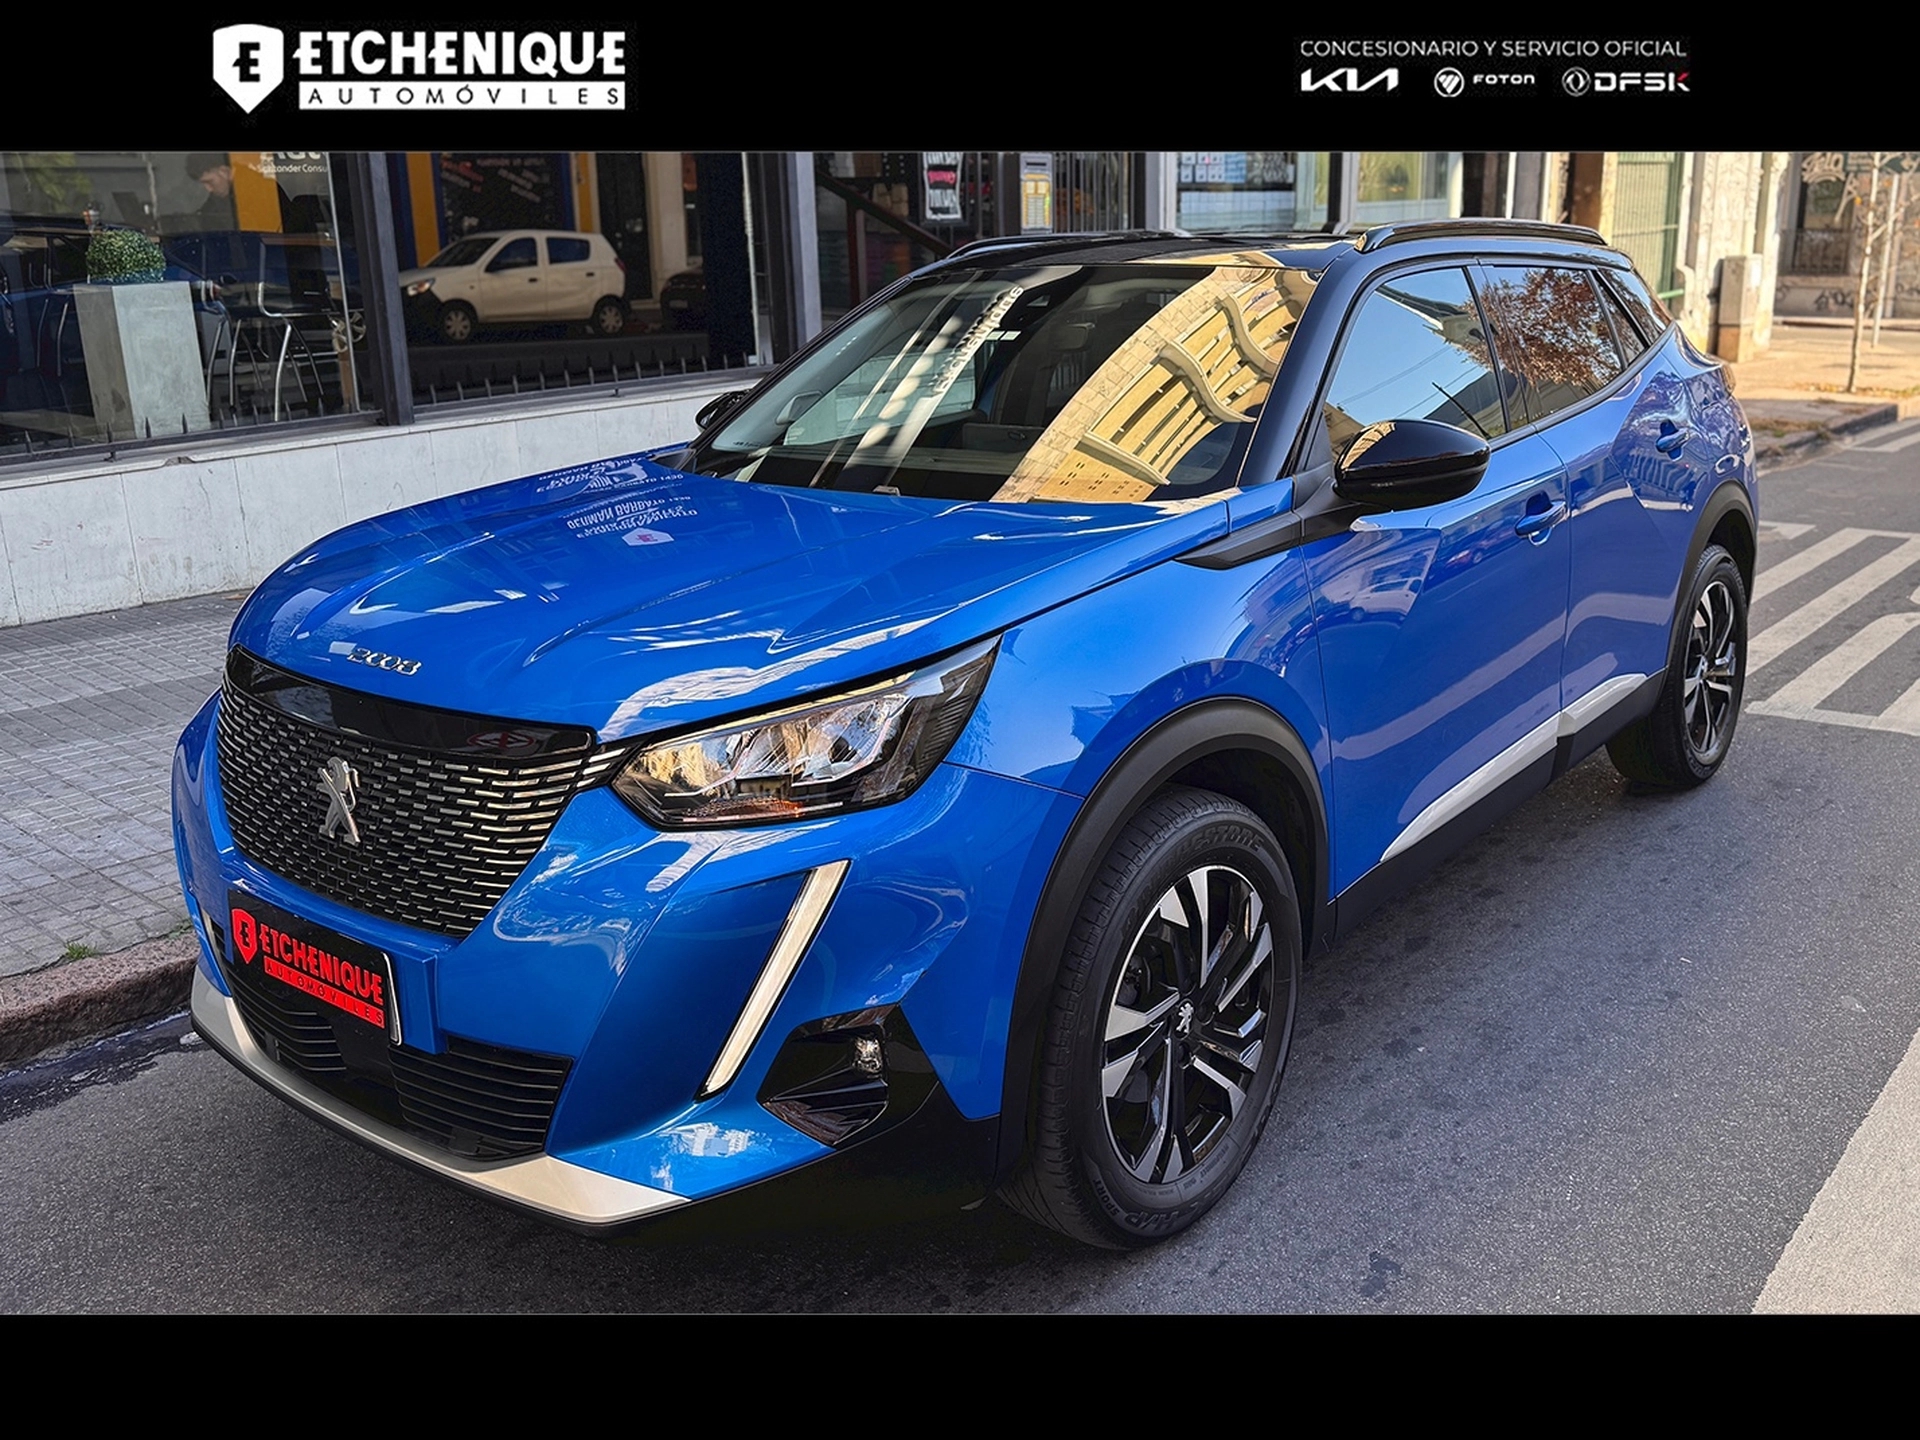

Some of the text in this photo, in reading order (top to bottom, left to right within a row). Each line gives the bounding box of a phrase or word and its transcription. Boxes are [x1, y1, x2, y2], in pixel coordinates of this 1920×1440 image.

[347, 641, 422, 676] 2008
[258, 923, 384, 1006] ETCHENIQUE
[1093, 1178, 1121, 1217] SPORT
